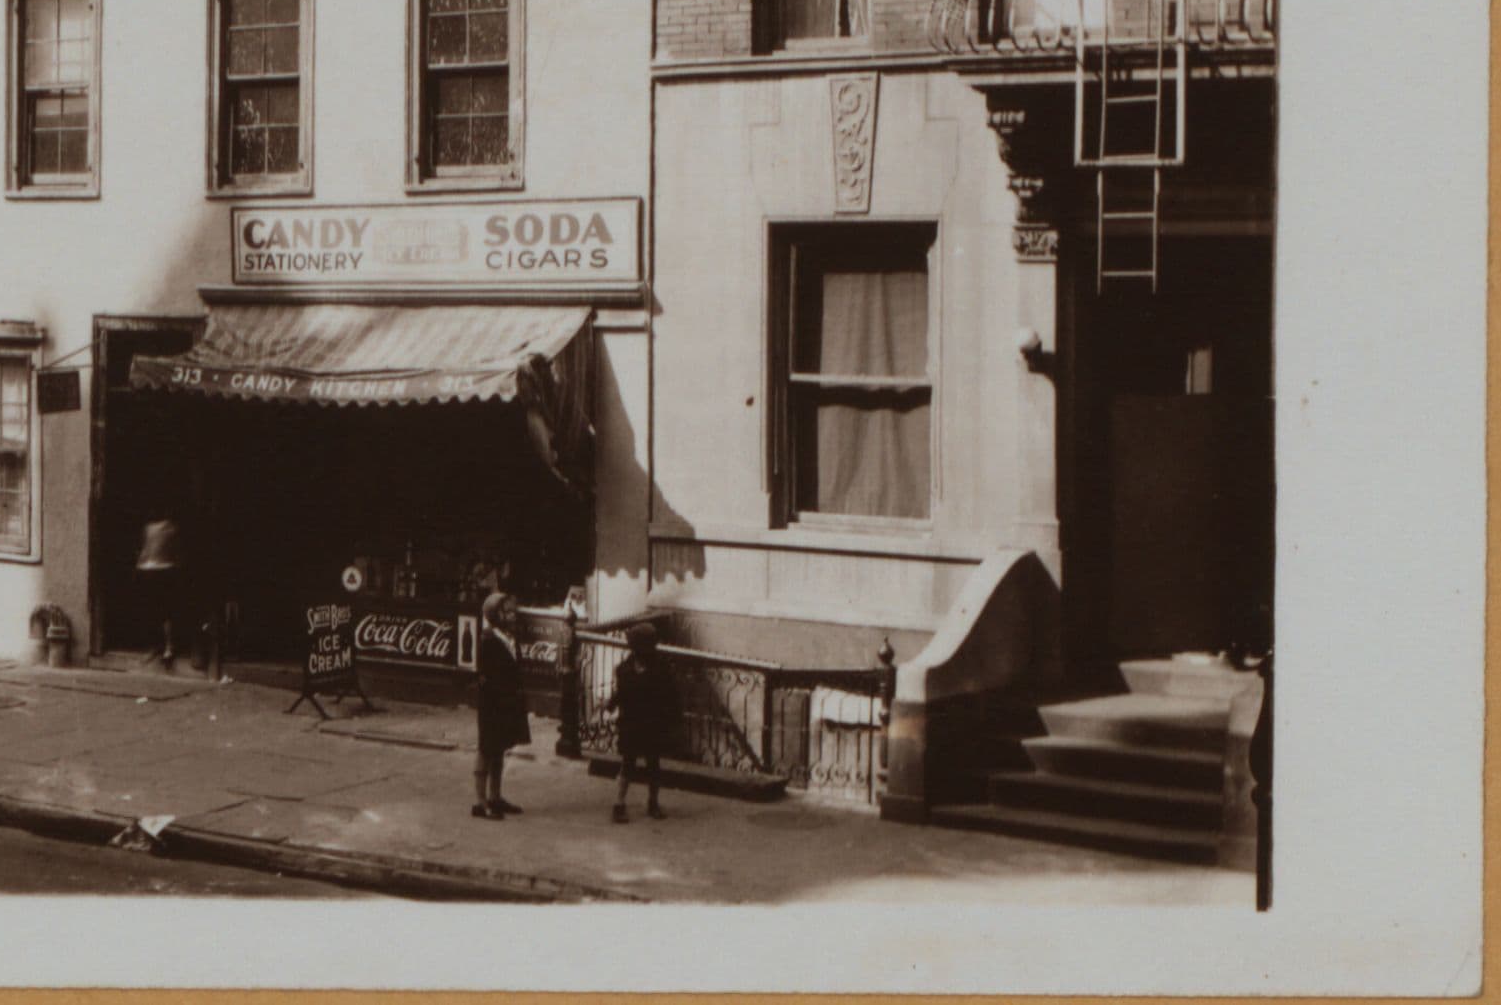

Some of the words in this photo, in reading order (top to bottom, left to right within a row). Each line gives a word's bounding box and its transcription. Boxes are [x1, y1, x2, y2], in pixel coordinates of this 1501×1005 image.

[243, 218, 371, 249] CANDY
[484, 212, 613, 246] SODA
[244, 252, 363, 272] STATIONERY
[485, 248, 608, 270] CIGARS
[171, 367, 203, 384] 313
[231, 373, 296, 392] CANDY
[309, 379, 408, 396] KITCHEN
[318, 635, 341, 652] ICE
[308, 646, 352, 674] CREAM
